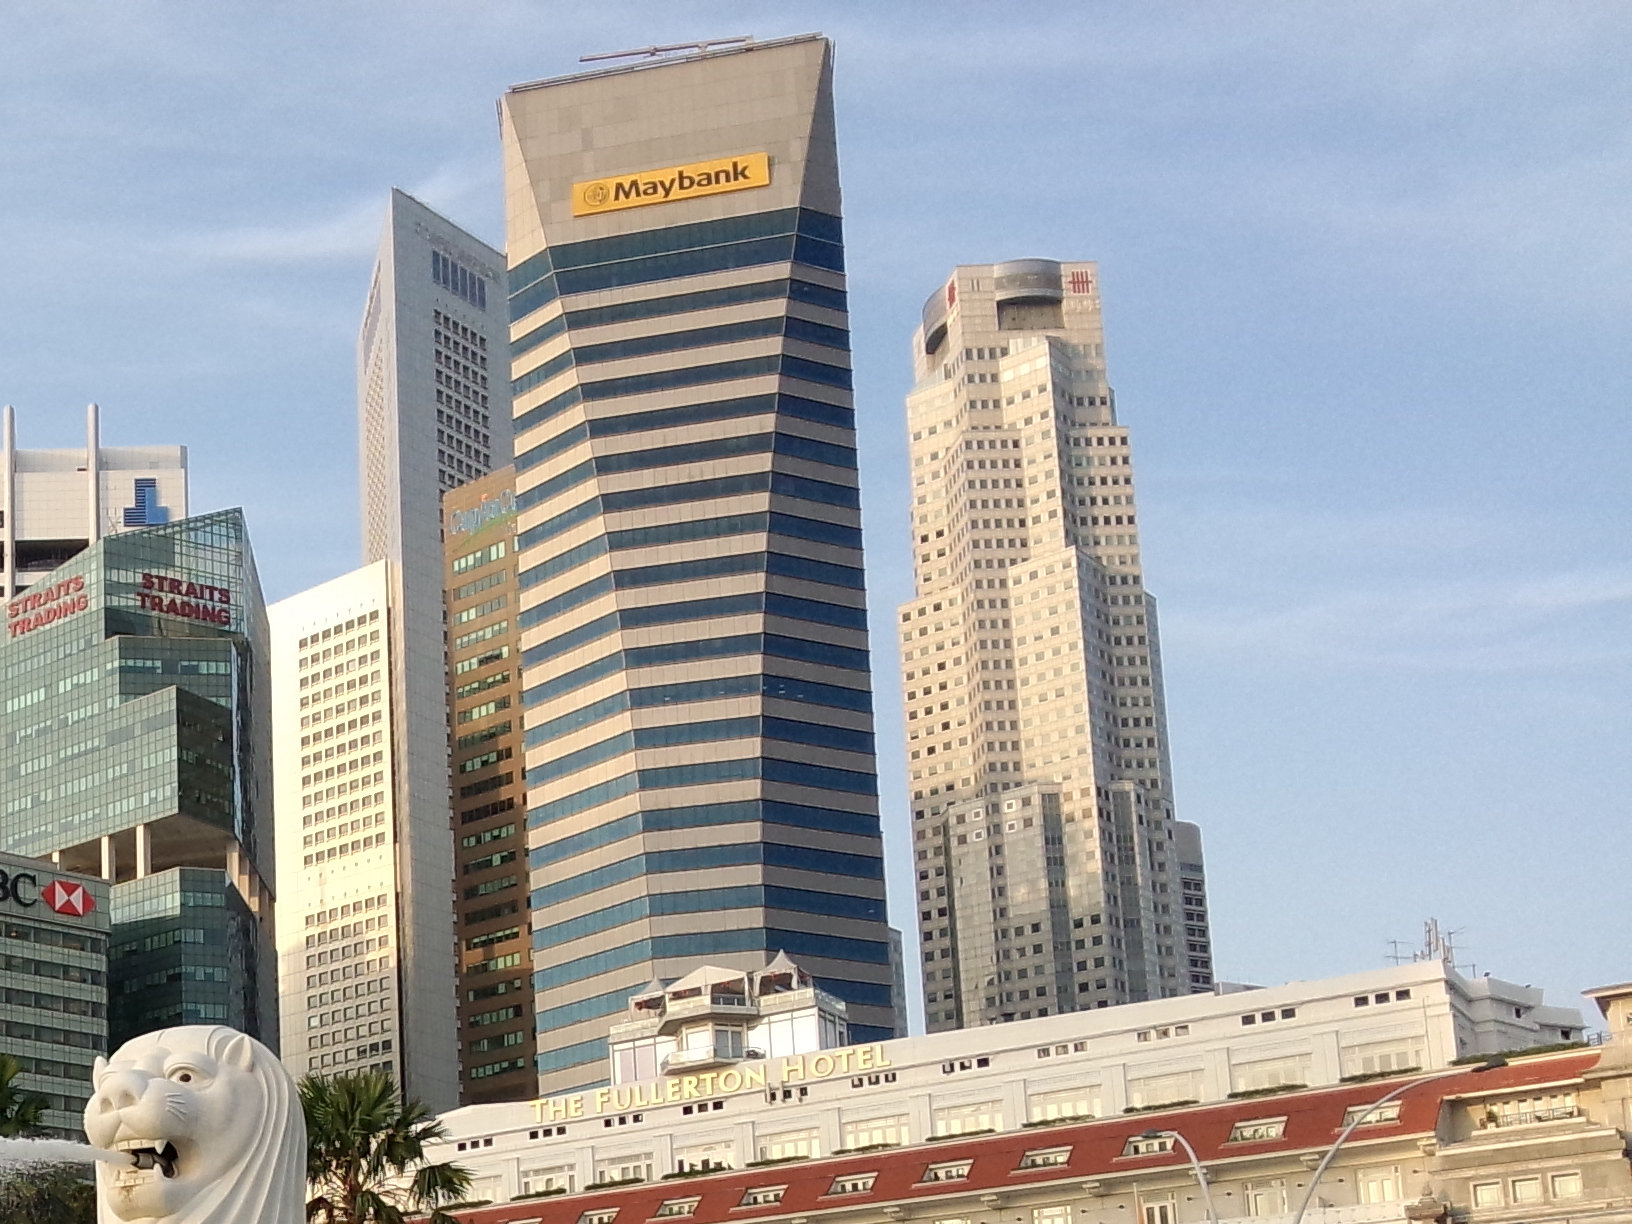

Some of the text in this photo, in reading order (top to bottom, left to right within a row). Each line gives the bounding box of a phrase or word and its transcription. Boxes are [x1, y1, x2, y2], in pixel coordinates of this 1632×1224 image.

[612, 161, 751, 202] Maybank
[8, 575, 84, 618] STRAITS
[136, 591, 231, 626] TRADING
[142, 572, 230, 604] STRAITS
[8, 594, 89, 638] TRADING
[530, 1044, 892, 1123] THE FULLERTON HOTEL
